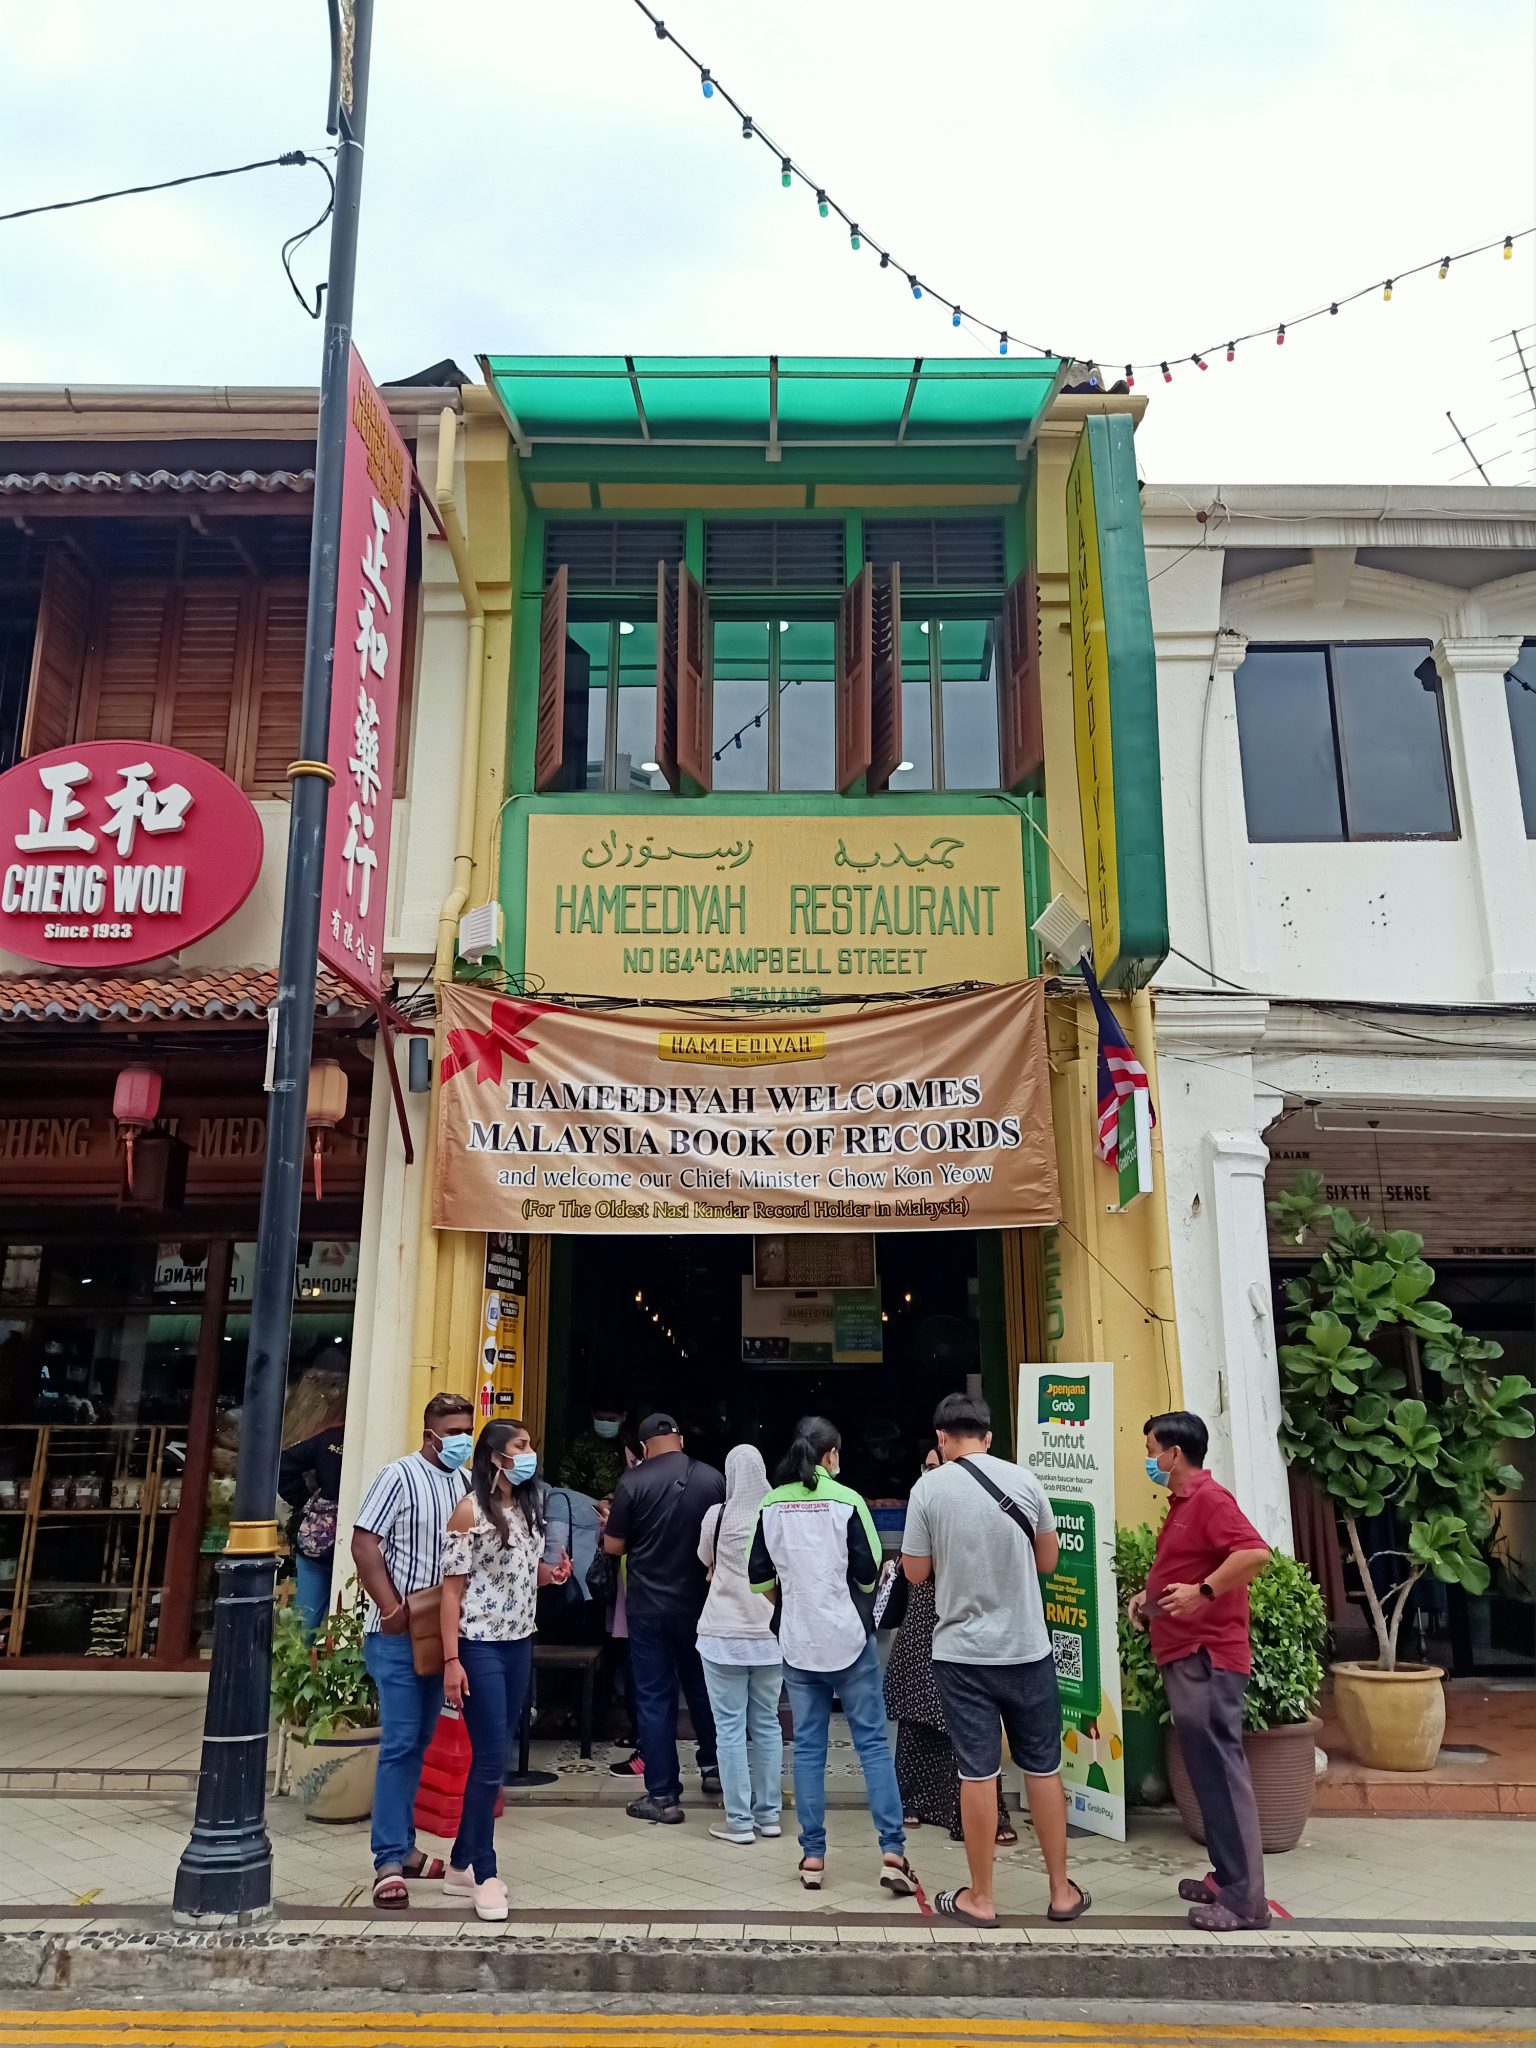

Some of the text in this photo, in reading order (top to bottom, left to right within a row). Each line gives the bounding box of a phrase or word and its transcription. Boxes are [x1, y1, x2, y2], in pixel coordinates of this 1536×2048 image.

[15, 761, 195, 859] 正和
[1, 864, 187, 915] CHENG WOH
[555, 885, 1000, 935] HAMEEDIYAH RESTAURANT
[44, 923, 133, 939] Since 1933
[330, 907, 377, 976] 有限公司
[623, 948, 654, 974] NO
[705, 948, 832, 975] CAMPBELL
[838, 949, 928, 975] STREET
[671, 1035, 812, 1054] HAMEEDIYAH
[509, 1075, 981, 1114] HAMEEDIYAH WELCOMES
[470, 1116, 1020, 1156] MALAYSIA BOOK OF RECORDS
[499, 1164, 993, 1189] and welcome our Chief Minister Chow Kon Yeow
[1325, 1185, 1432, 1201] SIXTH SENSE
[521, 1198, 969, 1219] (For The Oldest Nasi Kandar Record Holder In Malaysia)
[1051, 1399, 1076, 1412] Grab
[1041, 1431, 1085, 1450] Tuntut
[1028, 1451, 1099, 1471] ePENJANA.
[1043, 1483, 1055, 1491] Grab
[1058, 1474, 1094, 1485] baucar-baucar
[1055, 1514, 1085, 1531] ntut
[1046, 1602, 1088, 1628] RM75
[1087, 1802, 1114, 1821] GrabPay
